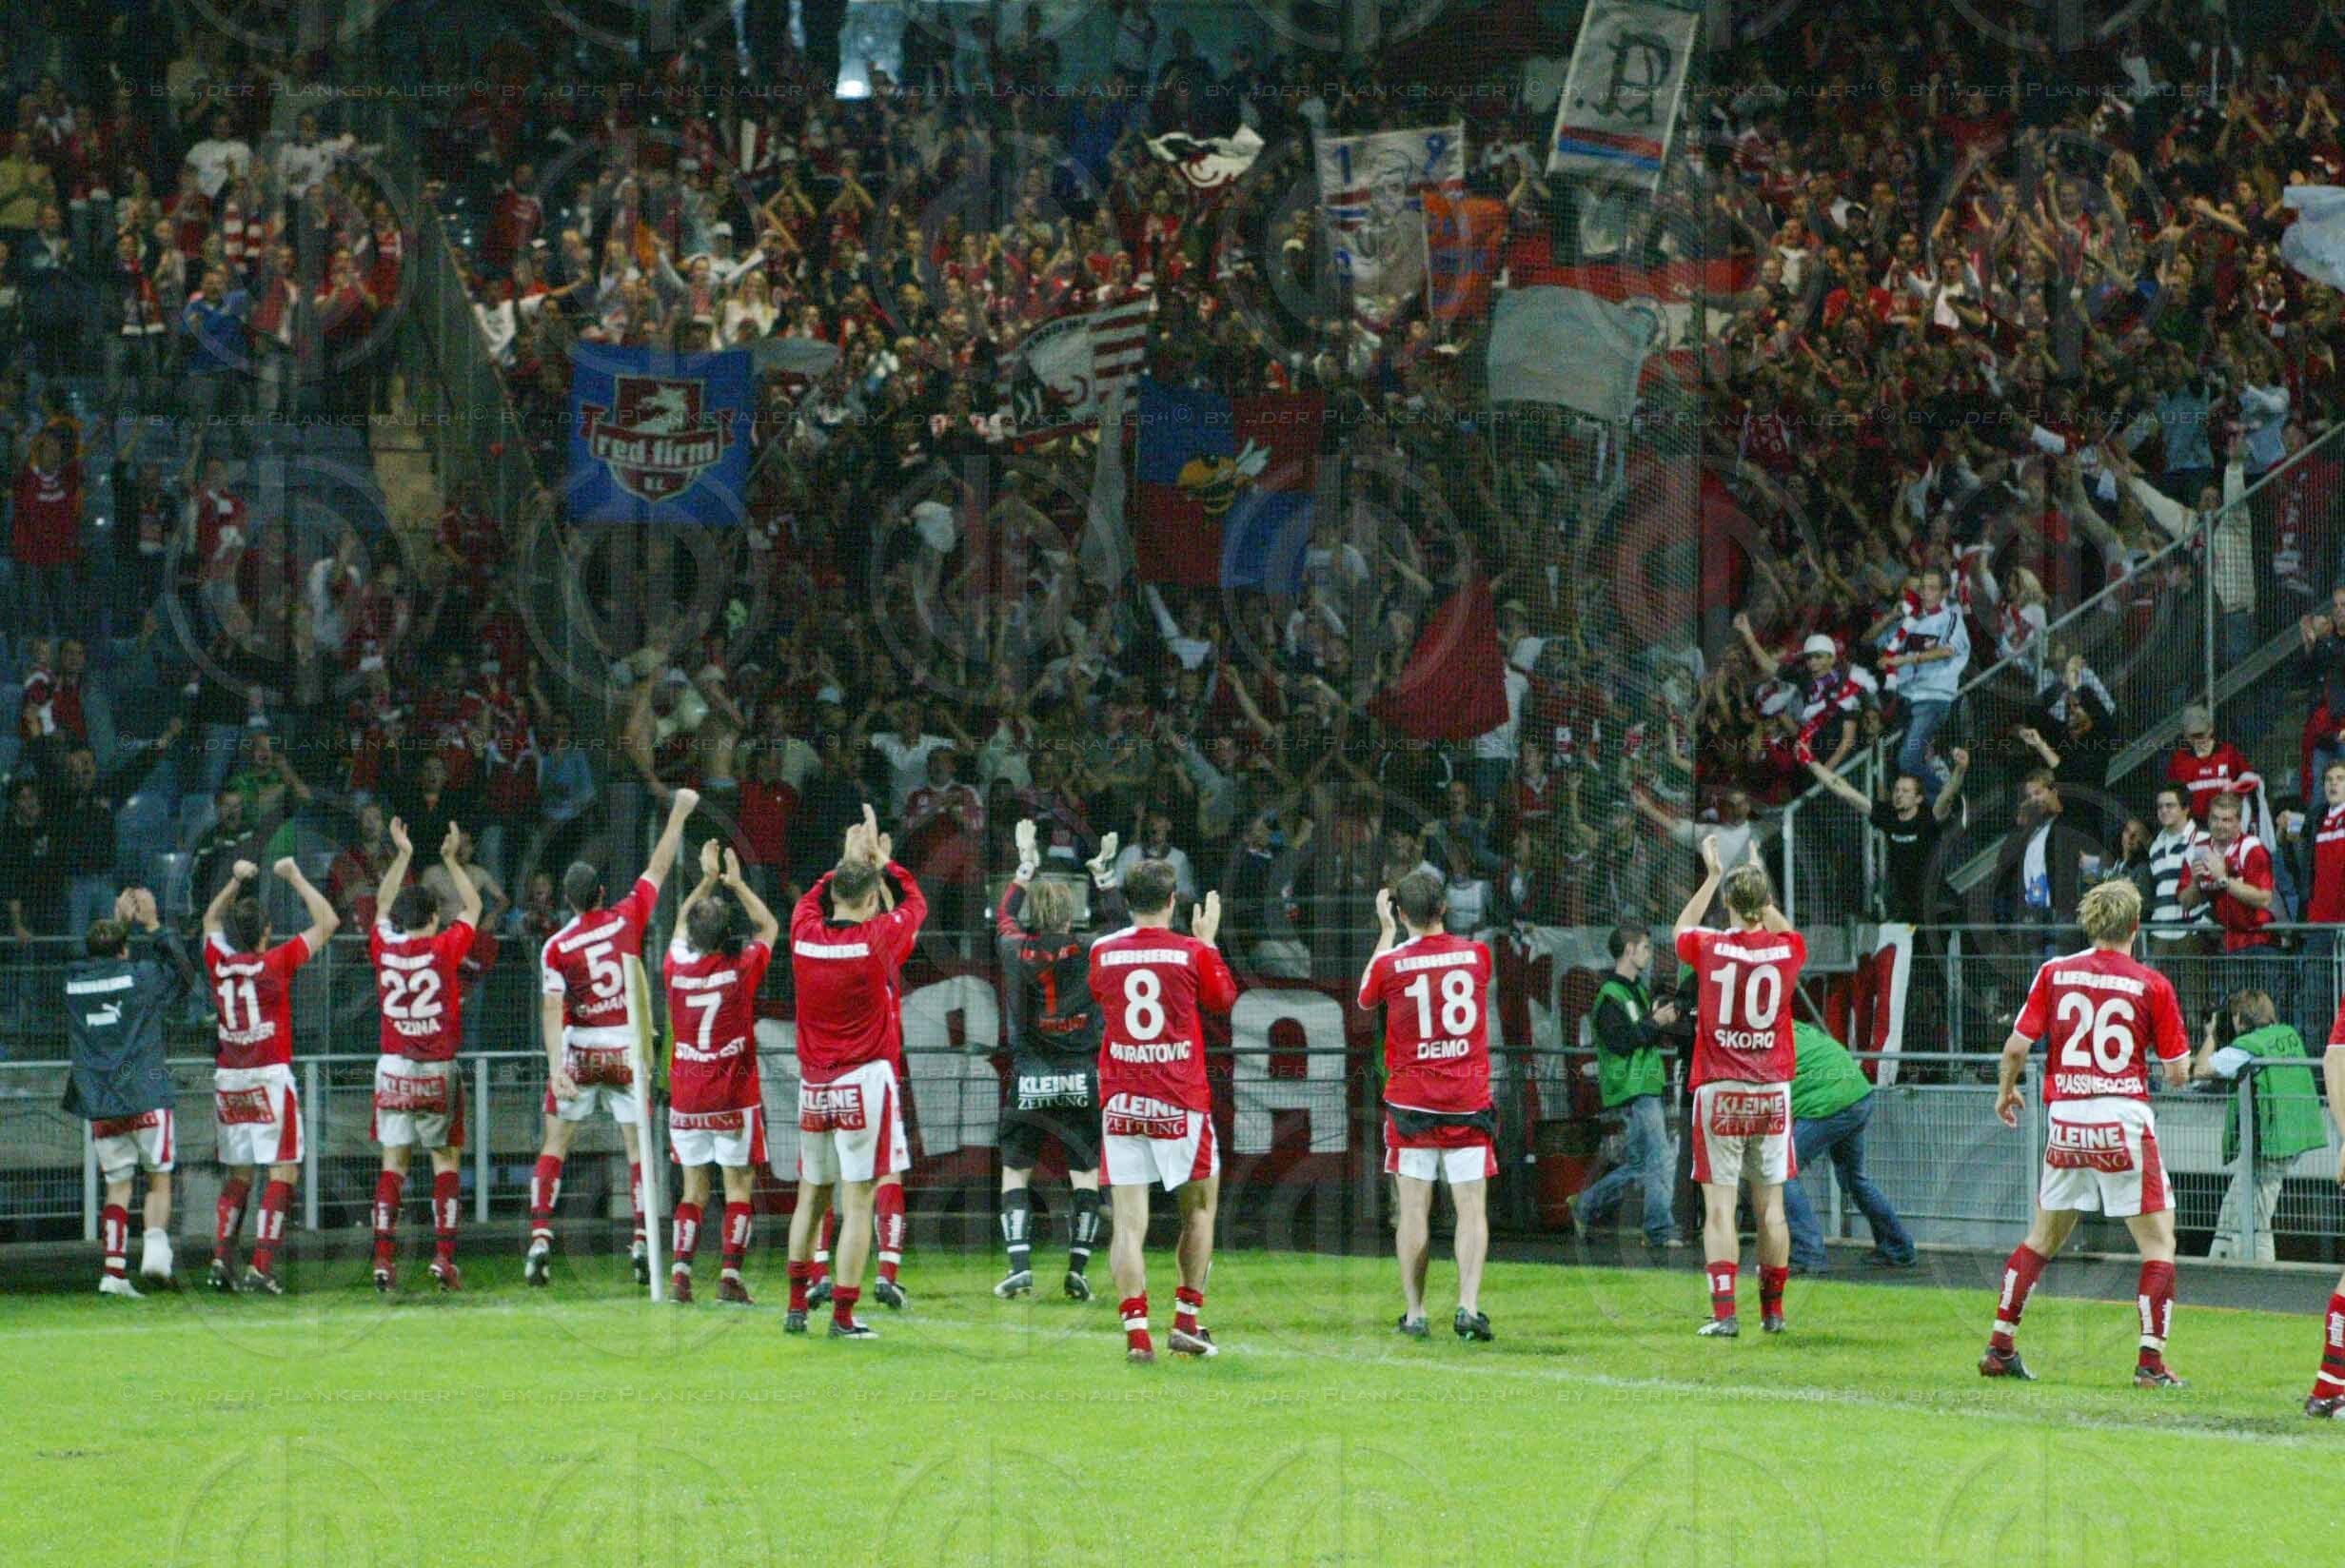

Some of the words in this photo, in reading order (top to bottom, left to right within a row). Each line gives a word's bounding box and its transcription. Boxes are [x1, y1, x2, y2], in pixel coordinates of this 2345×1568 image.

[381, 969, 443, 1020] 22
[583, 941, 624, 999] 5
[1710, 962, 1782, 1029] 10
[217, 976, 261, 1030] 11
[685, 991, 722, 1051] 7
[1123, 969, 1165, 1040] 8
[1404, 969, 1478, 1039] 18
[1417, 1038, 1469, 1060] DEMO
[1714, 1029, 1776, 1050] SKORO
[2057, 991, 2135, 1073] 26
[1018, 1073, 1088, 1093] KLEINE
[1018, 1095, 1089, 1110] ZEITUNG
[1716, 1094, 1784, 1115] KLEINE
